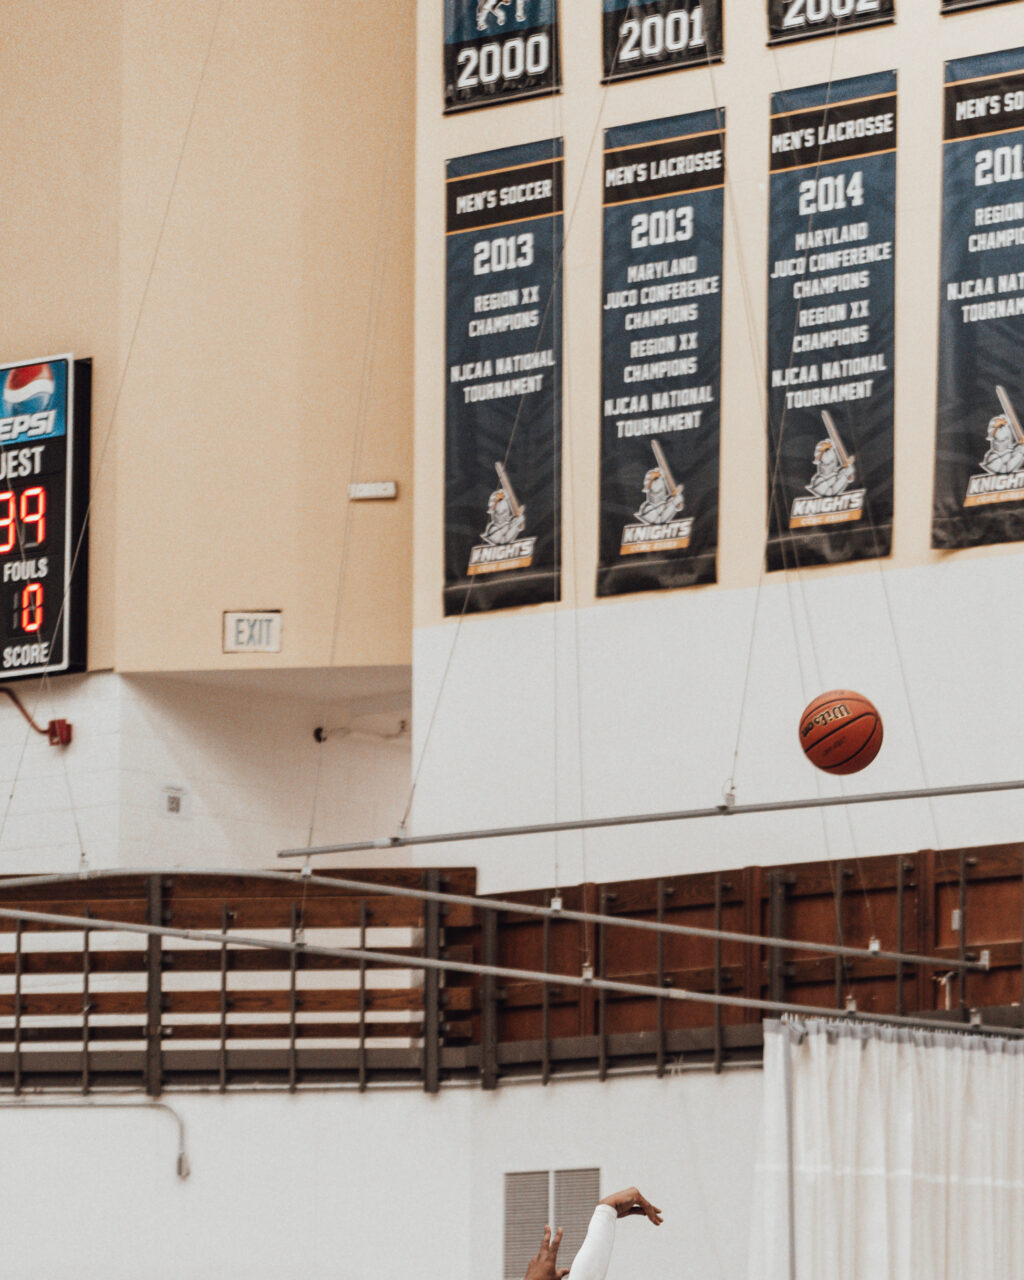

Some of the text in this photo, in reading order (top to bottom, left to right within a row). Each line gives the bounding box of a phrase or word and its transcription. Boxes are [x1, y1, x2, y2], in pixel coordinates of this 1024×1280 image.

[618, 5, 706, 63] 2001
[456, 34, 550, 90] 2000
[956, 95, 1000, 121] MEN'S
[772, 112, 894, 154] MEN'S LACROSSE
[606, 150, 722, 187] MEN'S LACROSSE
[456, 178, 553, 214] MEN'S SOCCER
[799, 171, 864, 216] 2014
[631, 206, 694, 249] 2013
[975, 202, 1024, 226] REGION
[795, 222, 868, 250] MARYLAND
[474, 232, 534, 276] 2013
[771, 242, 892, 278] JUCO CONFERENCE
[627, 256, 698, 283] MARYLAND
[604, 276, 720, 310] JUCO CONFERENCE
[793, 270, 870, 299] CHAMPIONS
[948, 277, 994, 300] NJCAA
[474, 286, 540, 312] REGION XX
[468, 310, 540, 337] CHAMPIONS
[625, 304, 698, 330] CHAMPIONS
[800, 300, 870, 327] REGION XX
[630, 332, 698, 358] REGION XX
[793, 325, 870, 353] CHAMPIONS
[450, 349, 556, 382] NJCAA NATIONAL
[624, 356, 698, 383] CHAMPIONS
[772, 354, 886, 387] NJCAA NATIONAL
[463, 374, 544, 404] TOURNAMENT
[604, 386, 714, 416] NJCAA NATIONAL
[786, 380, 873, 410] TOURNAMENT
[616, 410, 702, 438] TOURNAMENT
[792, 491, 864, 515] KNIGHTS
[624, 520, 692, 543] KNIGHTS
[472, 540, 534, 563] KNIGHTS
[3, 556, 48, 582] FOULS
[22, 582, 43, 633] 0
[235, 618, 273, 646] EXIT
[3, 642, 50, 668] SCORE
